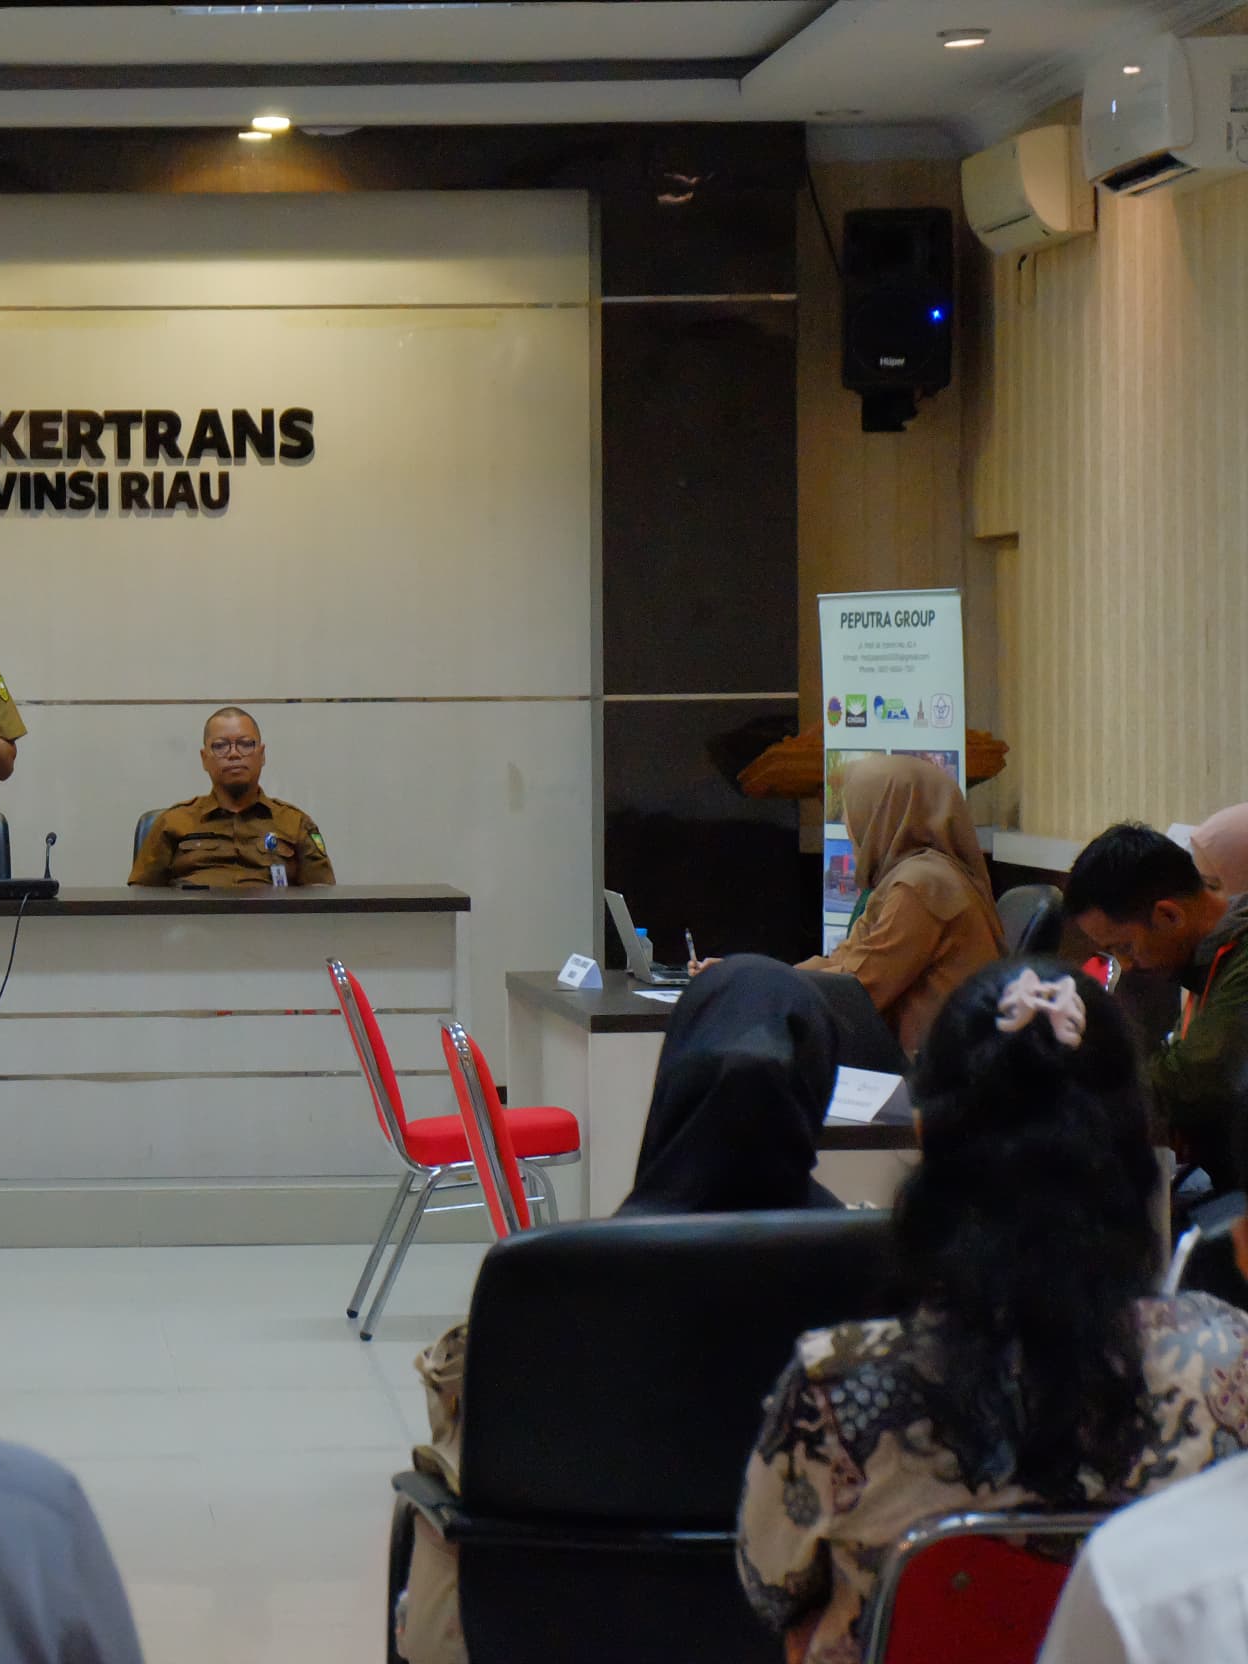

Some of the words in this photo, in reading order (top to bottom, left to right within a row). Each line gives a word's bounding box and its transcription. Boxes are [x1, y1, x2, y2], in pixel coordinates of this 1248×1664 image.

[120, 470, 231, 510] RIAU
[840, 611, 892, 629] PEPUTRA
[894, 609, 936, 628] GROUP
